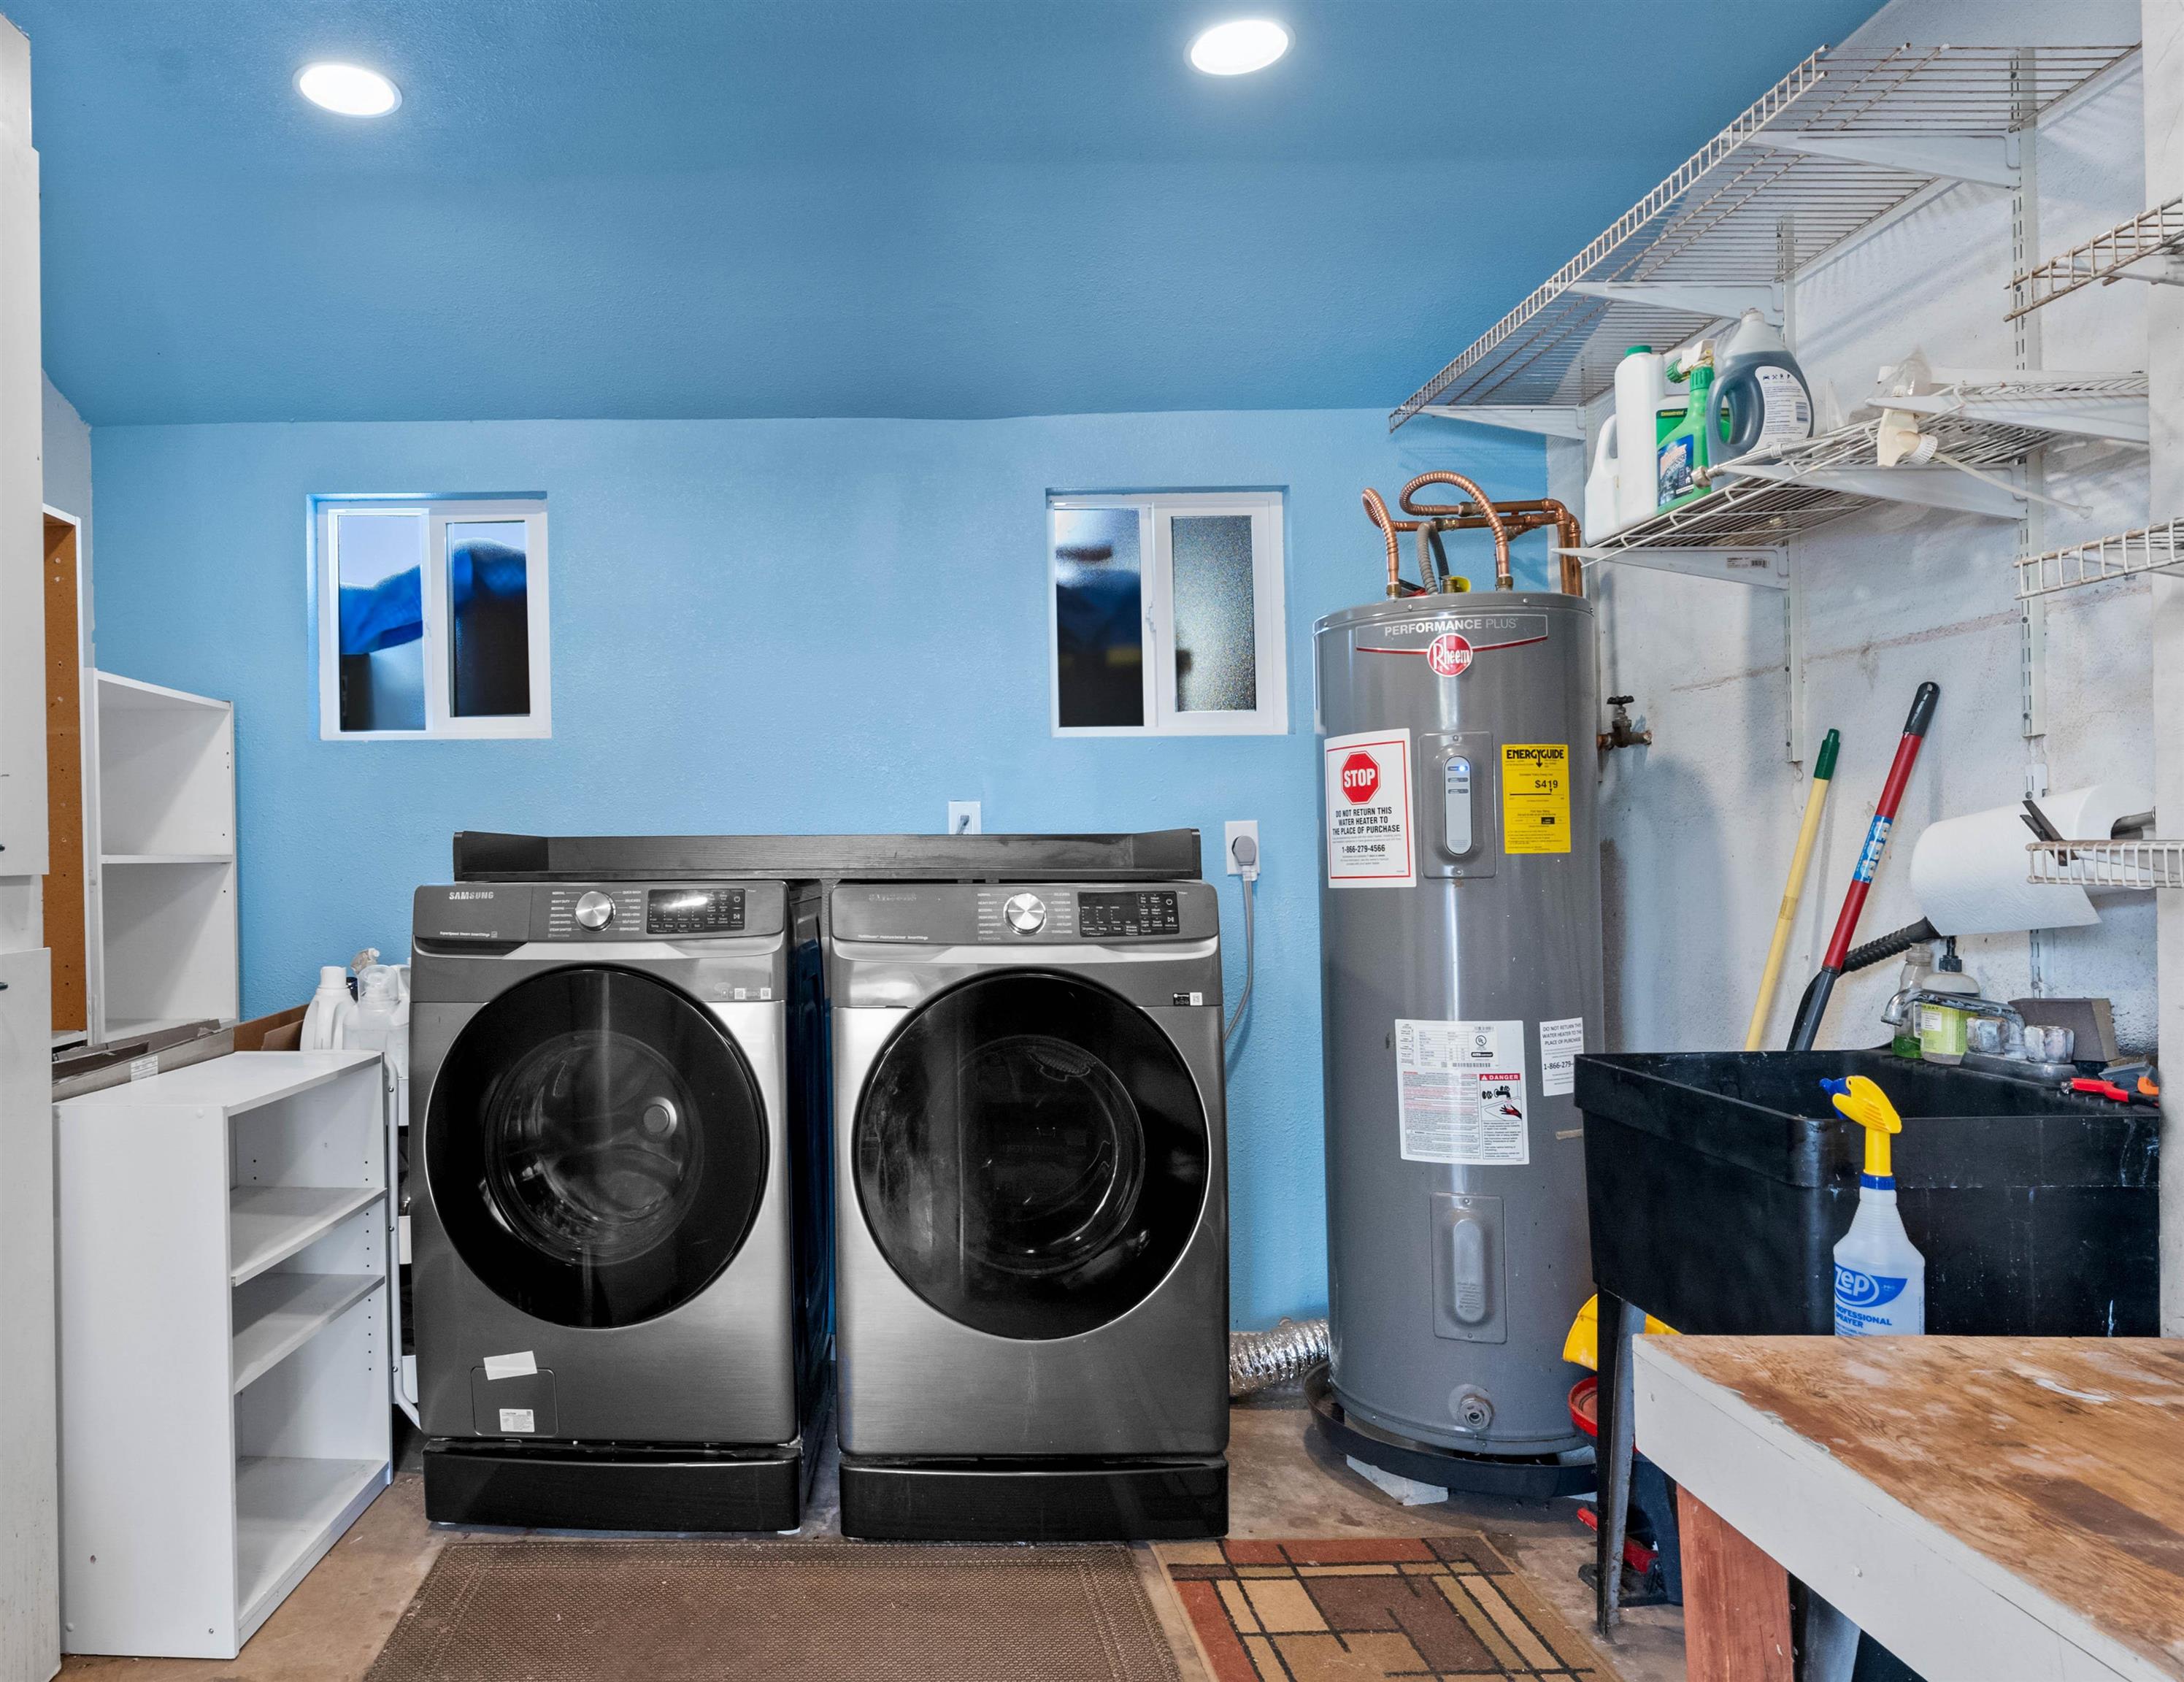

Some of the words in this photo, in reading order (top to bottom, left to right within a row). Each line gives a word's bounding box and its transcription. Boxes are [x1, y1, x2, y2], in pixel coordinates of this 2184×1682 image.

[1385, 619, 1482, 636] PERFORMANCE
[1433, 636, 1470, 670] Rheem
[1344, 768, 1375, 788] STOP
[1353, 807, 1375, 816] RETURN
[1377, 807, 1392, 815] THIS
[1356, 817, 1377, 825] HEATER
[1341, 827, 1356, 835] PLACE
[1366, 825, 1400, 834] PURCHASE
[1342, 845, 1385, 853] 1-866-279-4566
[449, 891, 493, 899] SAMSUNG
[1544, 1061, 1574, 1070] 1-866-279-
